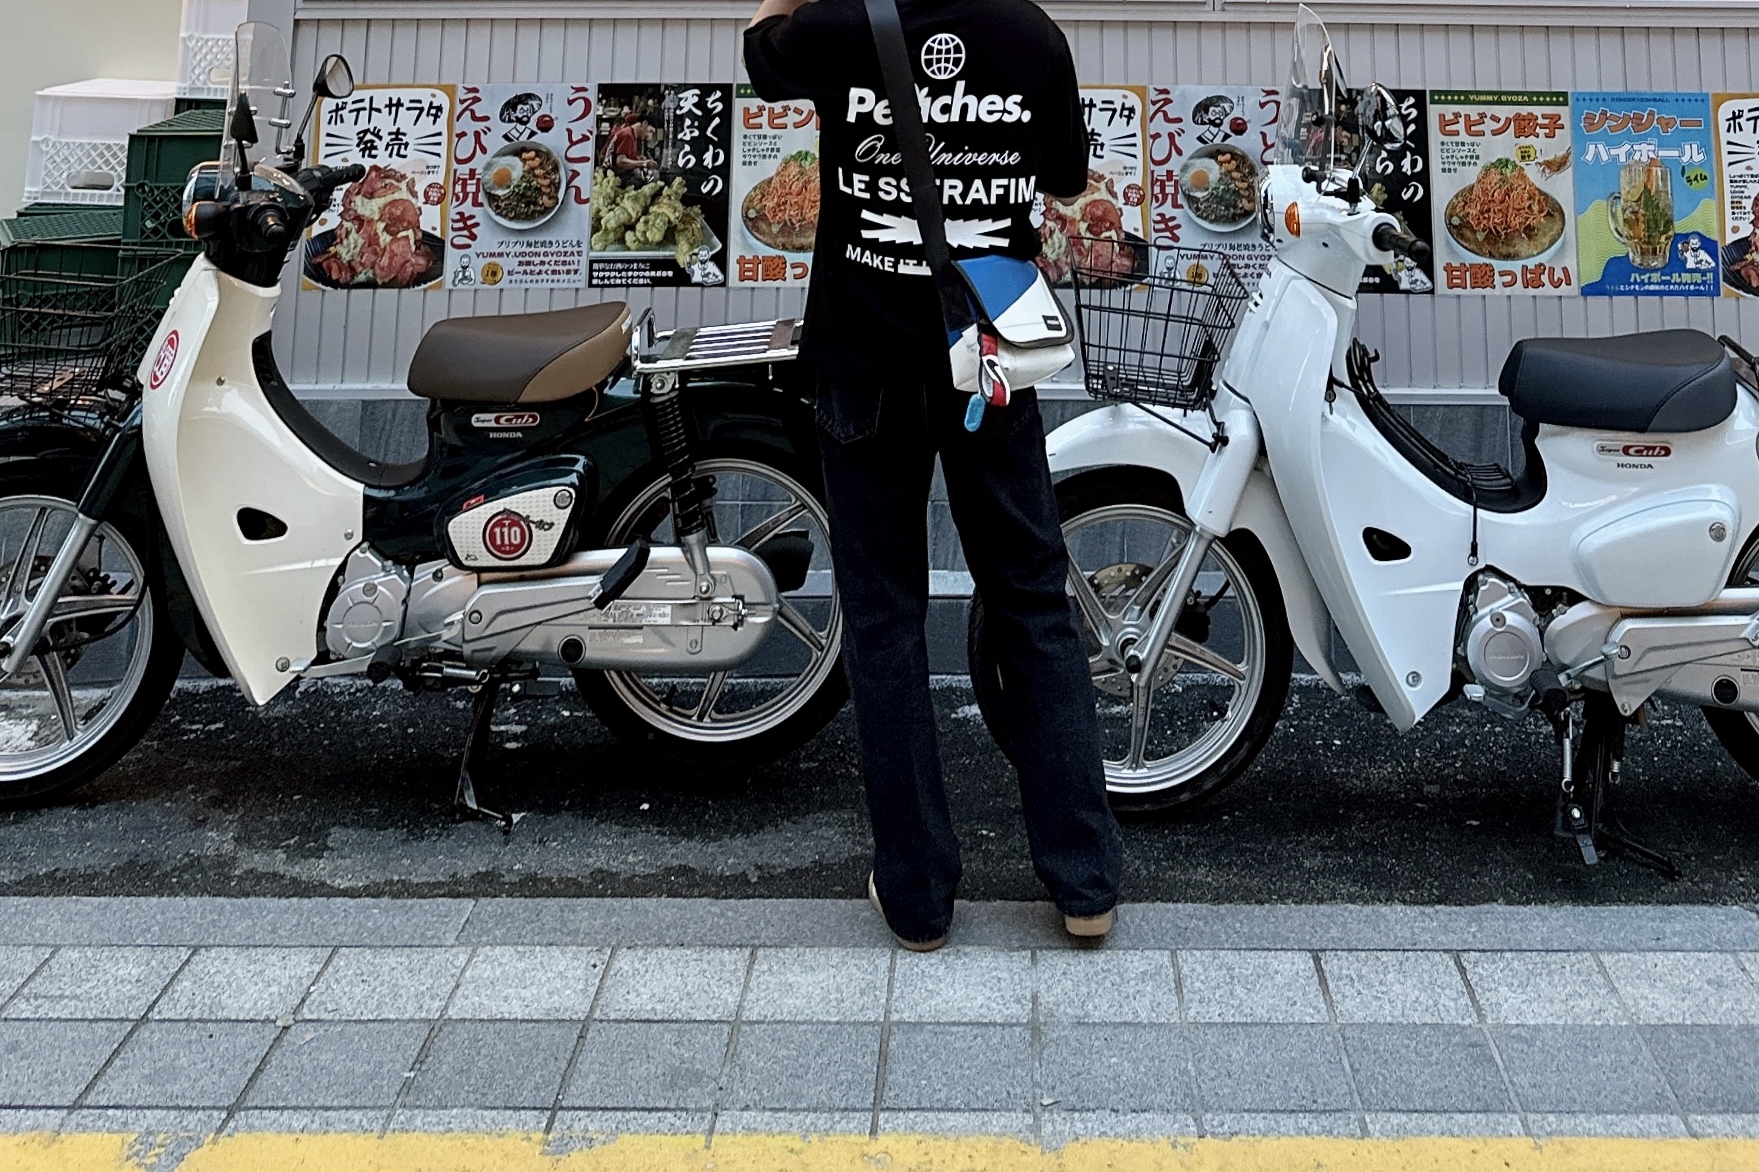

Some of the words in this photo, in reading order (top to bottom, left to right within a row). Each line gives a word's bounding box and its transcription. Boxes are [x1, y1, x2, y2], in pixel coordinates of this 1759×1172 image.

[327, 96, 443, 126] ポテトサラダ
[743, 105, 820, 130] ビビン
[1438, 111, 1564, 138] ビビン餃子
[1582, 108, 1703, 135] ジンジャー
[676, 89, 703, 169] 天ぷら
[356, 127, 409, 159] 発売
[565, 85, 594, 205] うどん
[701, 90, 725, 197] ちくわの
[855, 134, 902, 165] One
[1582, 138, 1706, 164] ハイボール
[449, 86, 491, 250] えび焼き
[1150, 87, 1185, 251] えび焼き
[1685, 173, 1708, 186] ライム
[838, 167, 870, 199] LE
[878, 175, 1037, 205] SSRAFIM
[845, 244, 895, 273] MAKE
[1444, 263, 1572, 289] 甘酸っぱい
[499, 415, 534, 425] Cub
[489, 431, 523, 439] HONDA
[1628, 446, 1666, 456] Cub
[1616, 462, 1655, 470] HONDA
[494, 526, 522, 546] 110
